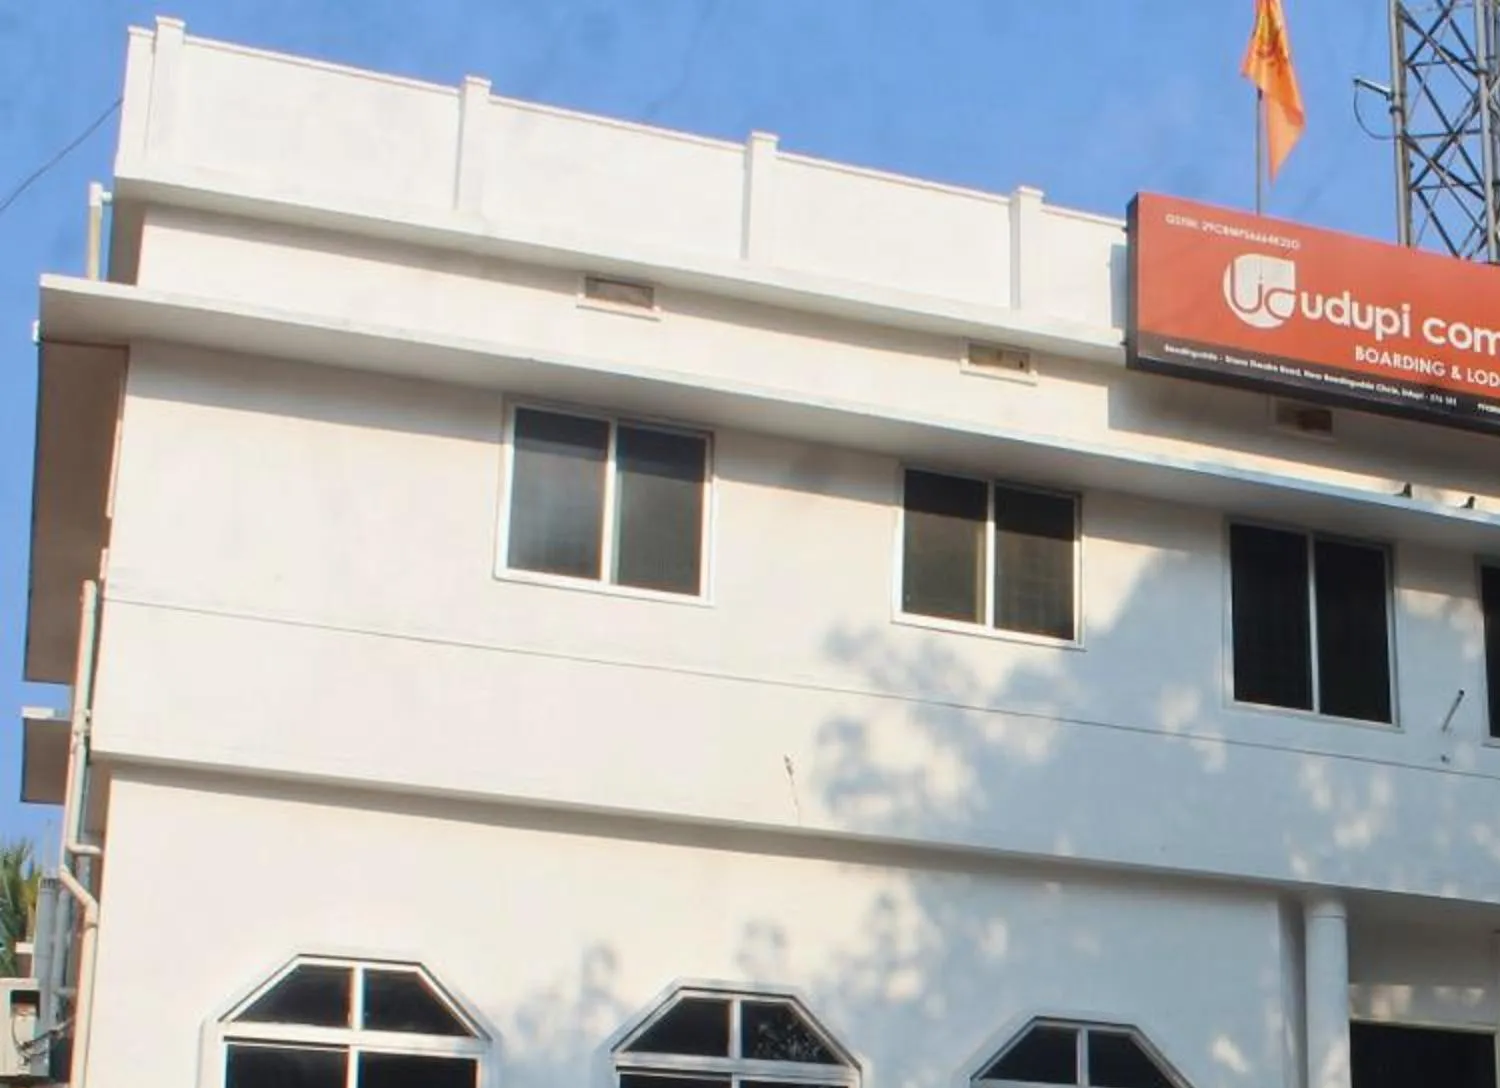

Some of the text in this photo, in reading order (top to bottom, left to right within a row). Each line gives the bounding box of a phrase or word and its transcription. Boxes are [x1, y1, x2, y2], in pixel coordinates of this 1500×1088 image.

[1300, 290, 1412, 342] udupi
[1354, 346, 1447, 378] BOARDING
[1450, 364, 1462, 381] &
